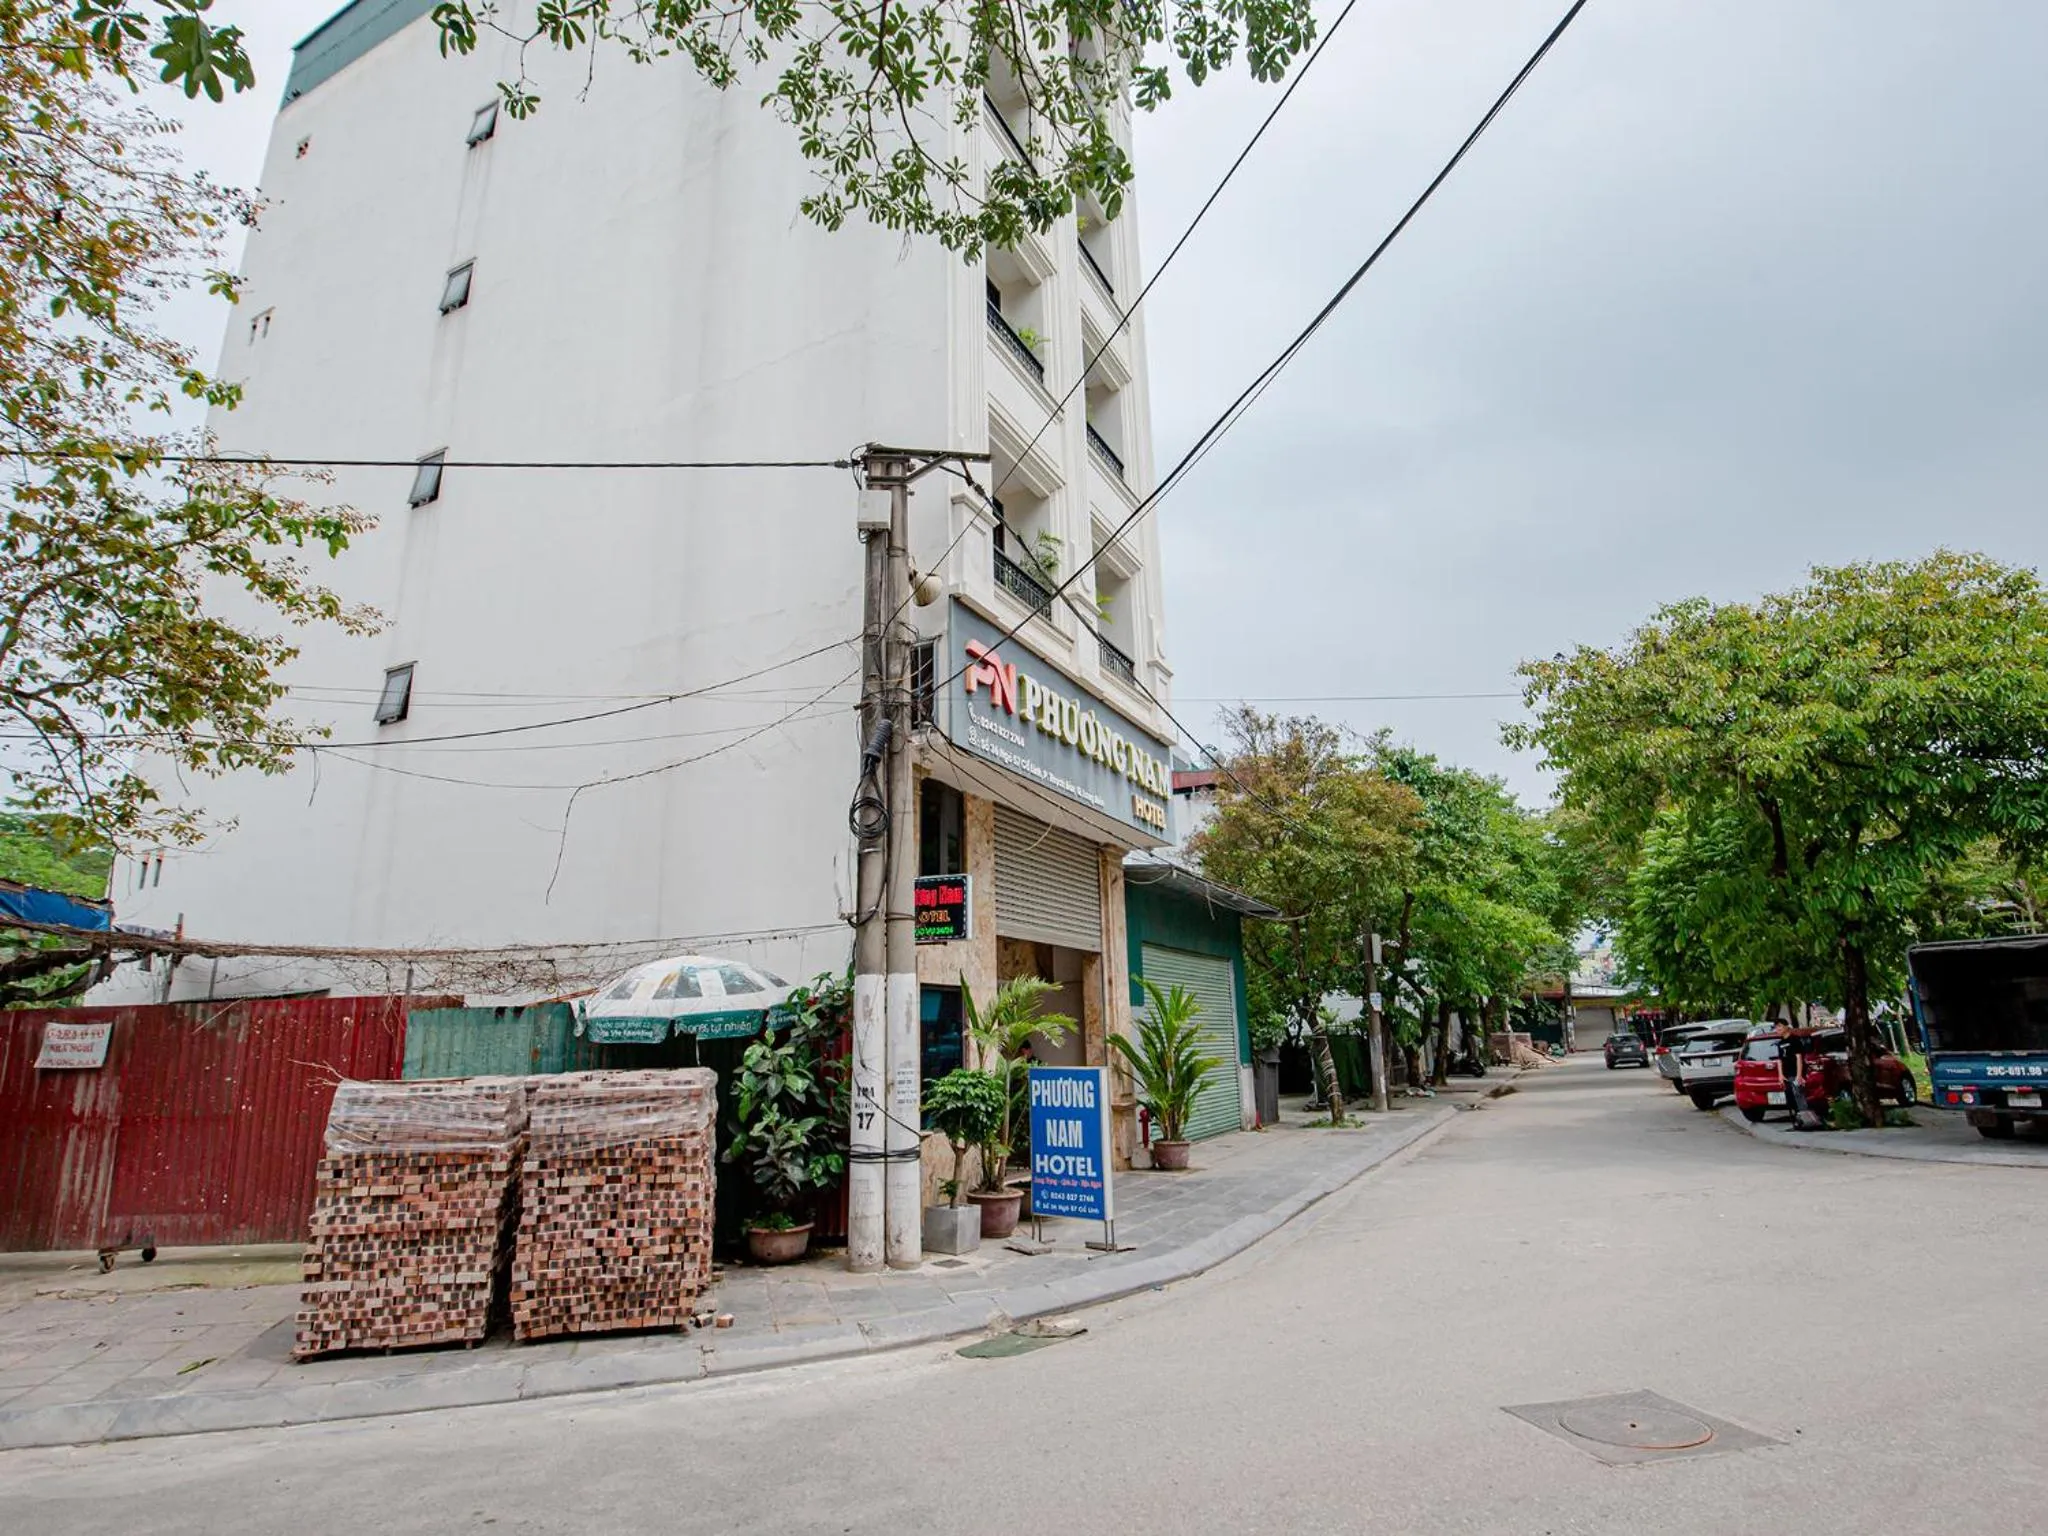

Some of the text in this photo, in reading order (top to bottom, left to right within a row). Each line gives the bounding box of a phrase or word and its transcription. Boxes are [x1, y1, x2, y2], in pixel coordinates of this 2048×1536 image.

[1019, 673, 1171, 801] PHƯƠNG NAM
[1132, 795, 1168, 830] HOTEL
[1031, 1077, 1095, 1108] PHƯƠNG
[857, 1112, 875, 1130] 17
[1046, 1119, 1083, 1149] NAM
[1035, 1154, 1097, 1177] HOTEL
